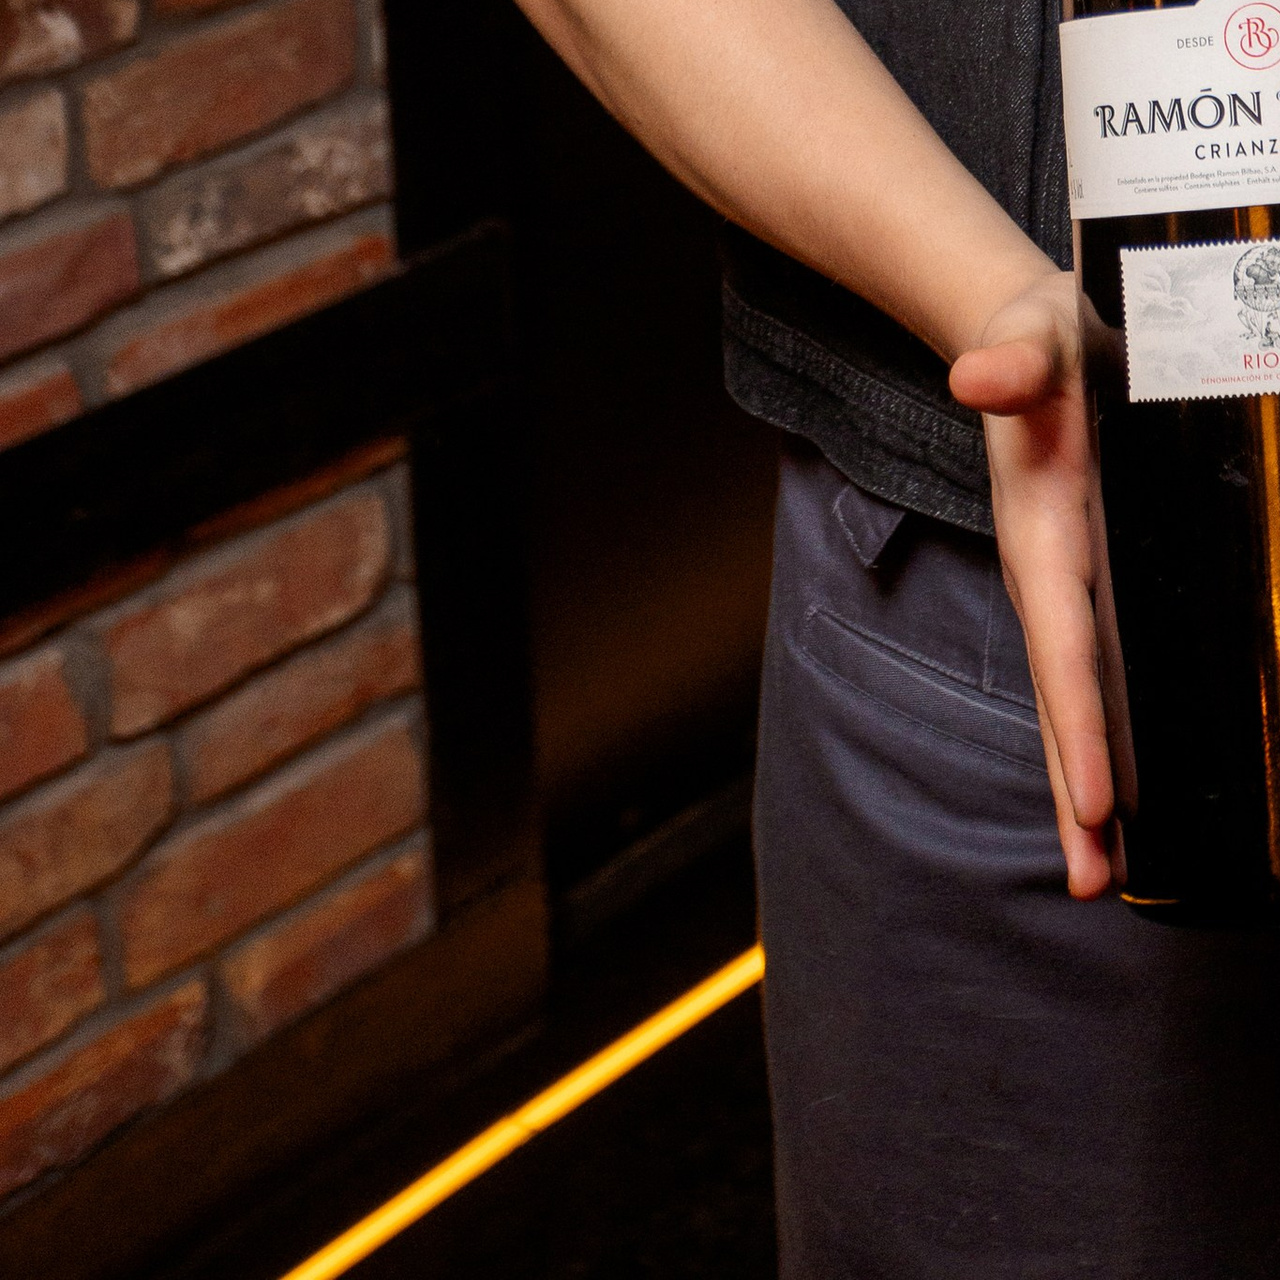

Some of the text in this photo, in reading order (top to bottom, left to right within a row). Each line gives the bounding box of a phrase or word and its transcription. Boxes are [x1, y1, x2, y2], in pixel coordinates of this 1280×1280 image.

[1177, 36, 1214, 49] DESDE
[1094, 88, 1263, 138] RAMÓN
[1201, 373, 1261, 385] DENOMINACIÓN
[1263, 372, 1274, 381] DE
